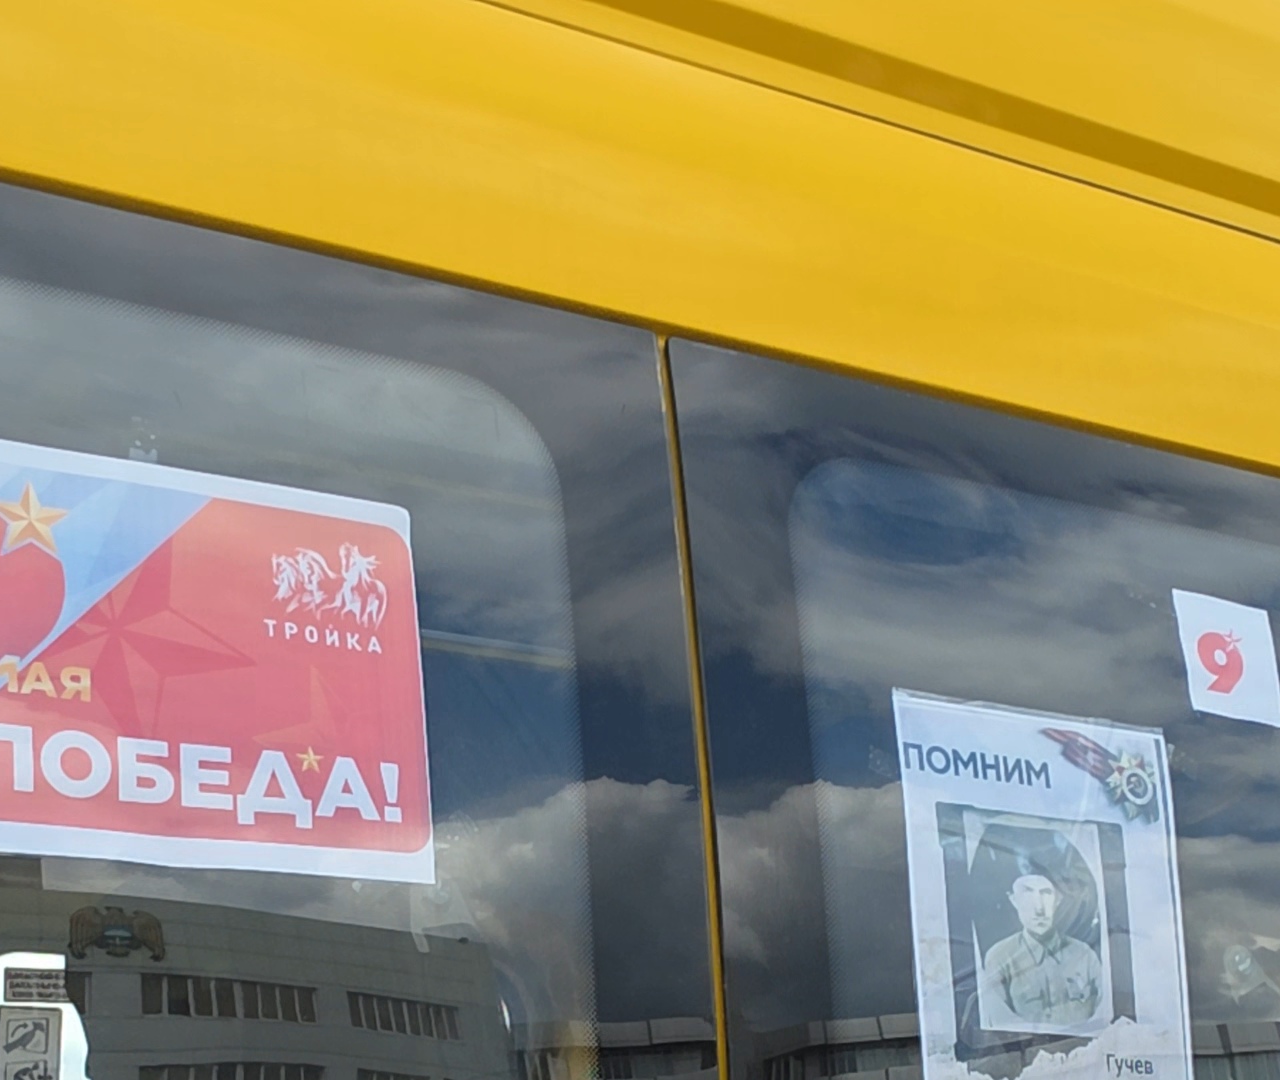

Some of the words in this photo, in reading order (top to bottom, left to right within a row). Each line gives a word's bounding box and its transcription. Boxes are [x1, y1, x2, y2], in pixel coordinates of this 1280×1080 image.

[263, 618, 382, 655] ТРОЙКА
[1197, 631, 1244, 694] 9
[902, 741, 1052, 789] ПОМНИМ
[1106, 1053, 1154, 1078] Гучев
